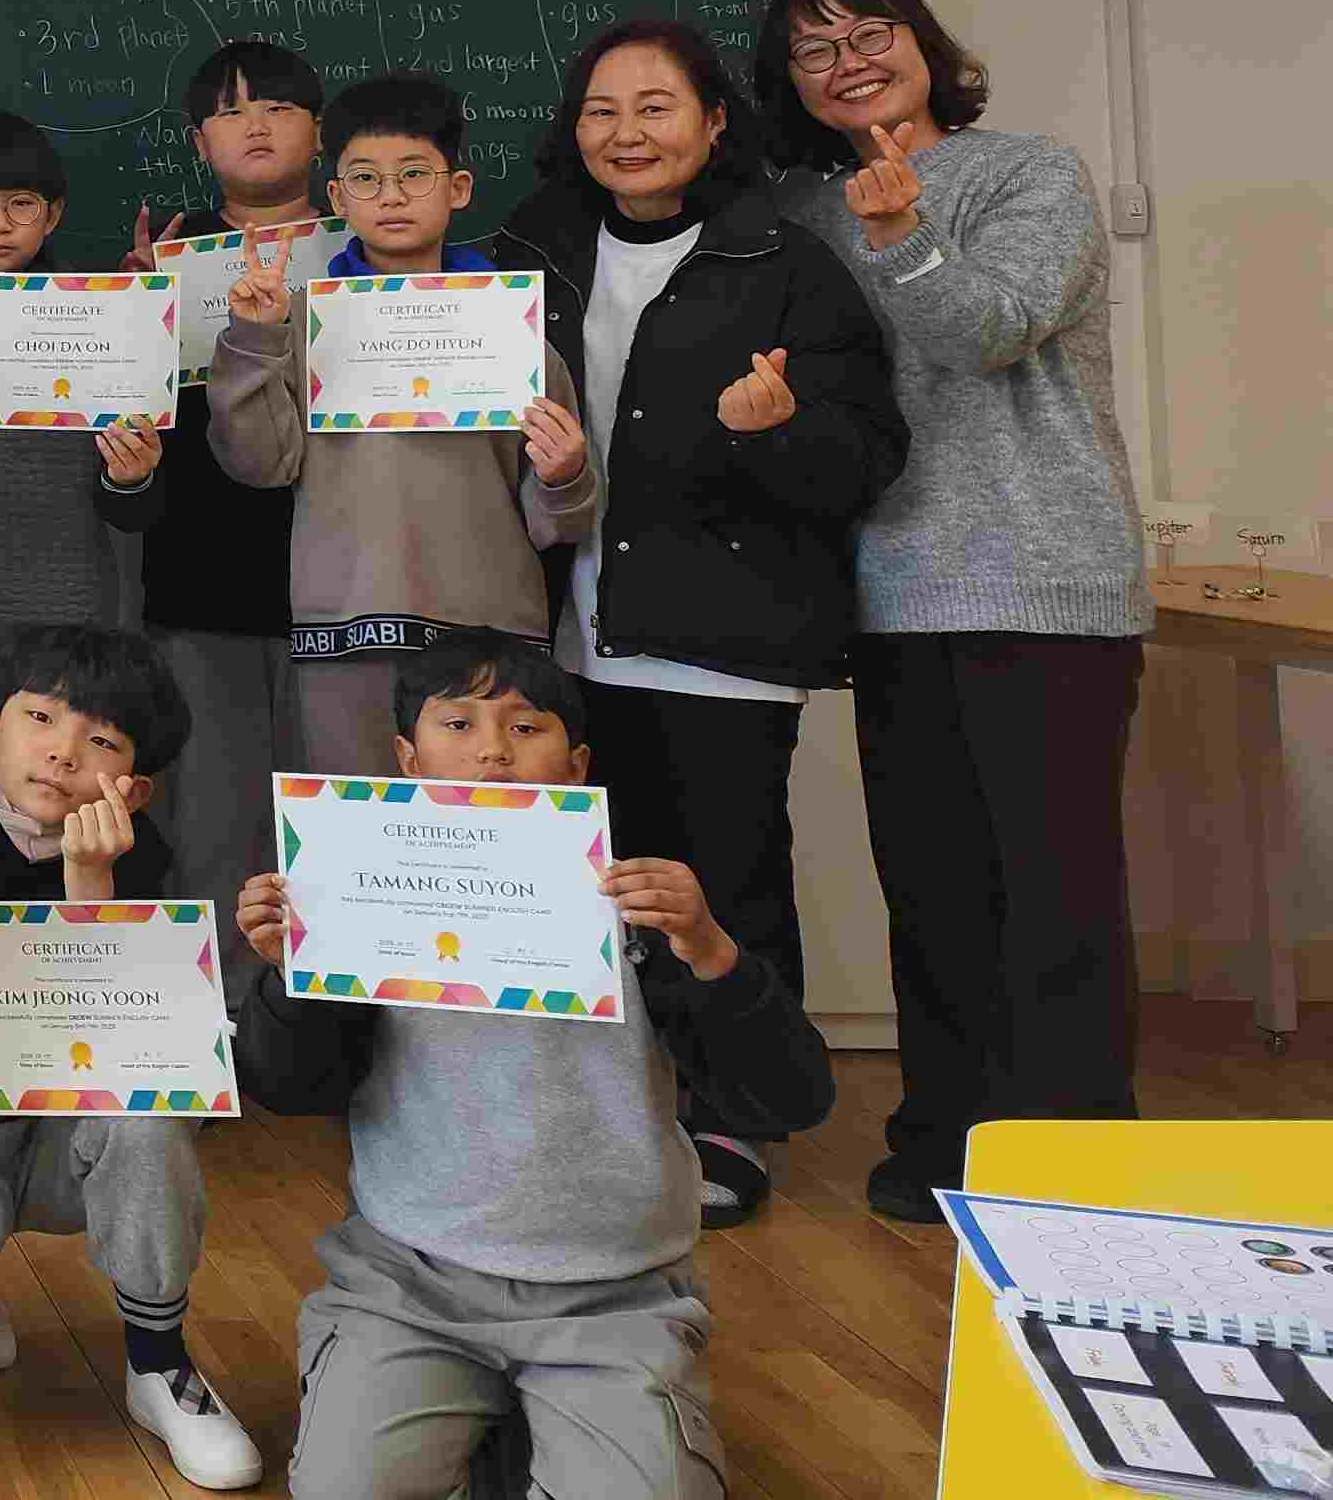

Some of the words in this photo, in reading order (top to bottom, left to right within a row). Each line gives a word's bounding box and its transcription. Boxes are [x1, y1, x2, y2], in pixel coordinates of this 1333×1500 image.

[405, 3, 462, 43] gas
[562, 1, 618, 42] gas
[36, 12, 102, 60] 3rd
[117, 13, 190, 60] planet
[485, 100, 558, 124] moons
[21, 305, 105, 317] CERTIFICATE
[378, 303, 462, 318] CERTIFICATE
[14, 339, 59, 353] CHOI
[60, 339, 83, 353] DA
[85, 339, 111, 353] ON
[357, 339, 404, 353] YANG
[406, 338, 431, 351] DO
[434, 337, 484, 351] HYUN
[1236, 528, 1286, 546] Saturn
[344, 622, 406, 649] SUABI
[382, 822, 499, 843] CERTIFICATE
[355, 870, 451, 894] TAMANG
[456, 877, 535, 899] SUYON
[21, 941, 123, 957] CERTIFICATE
[30, 990, 96, 1009] JEONG
[101, 990, 161, 1007] YOON
